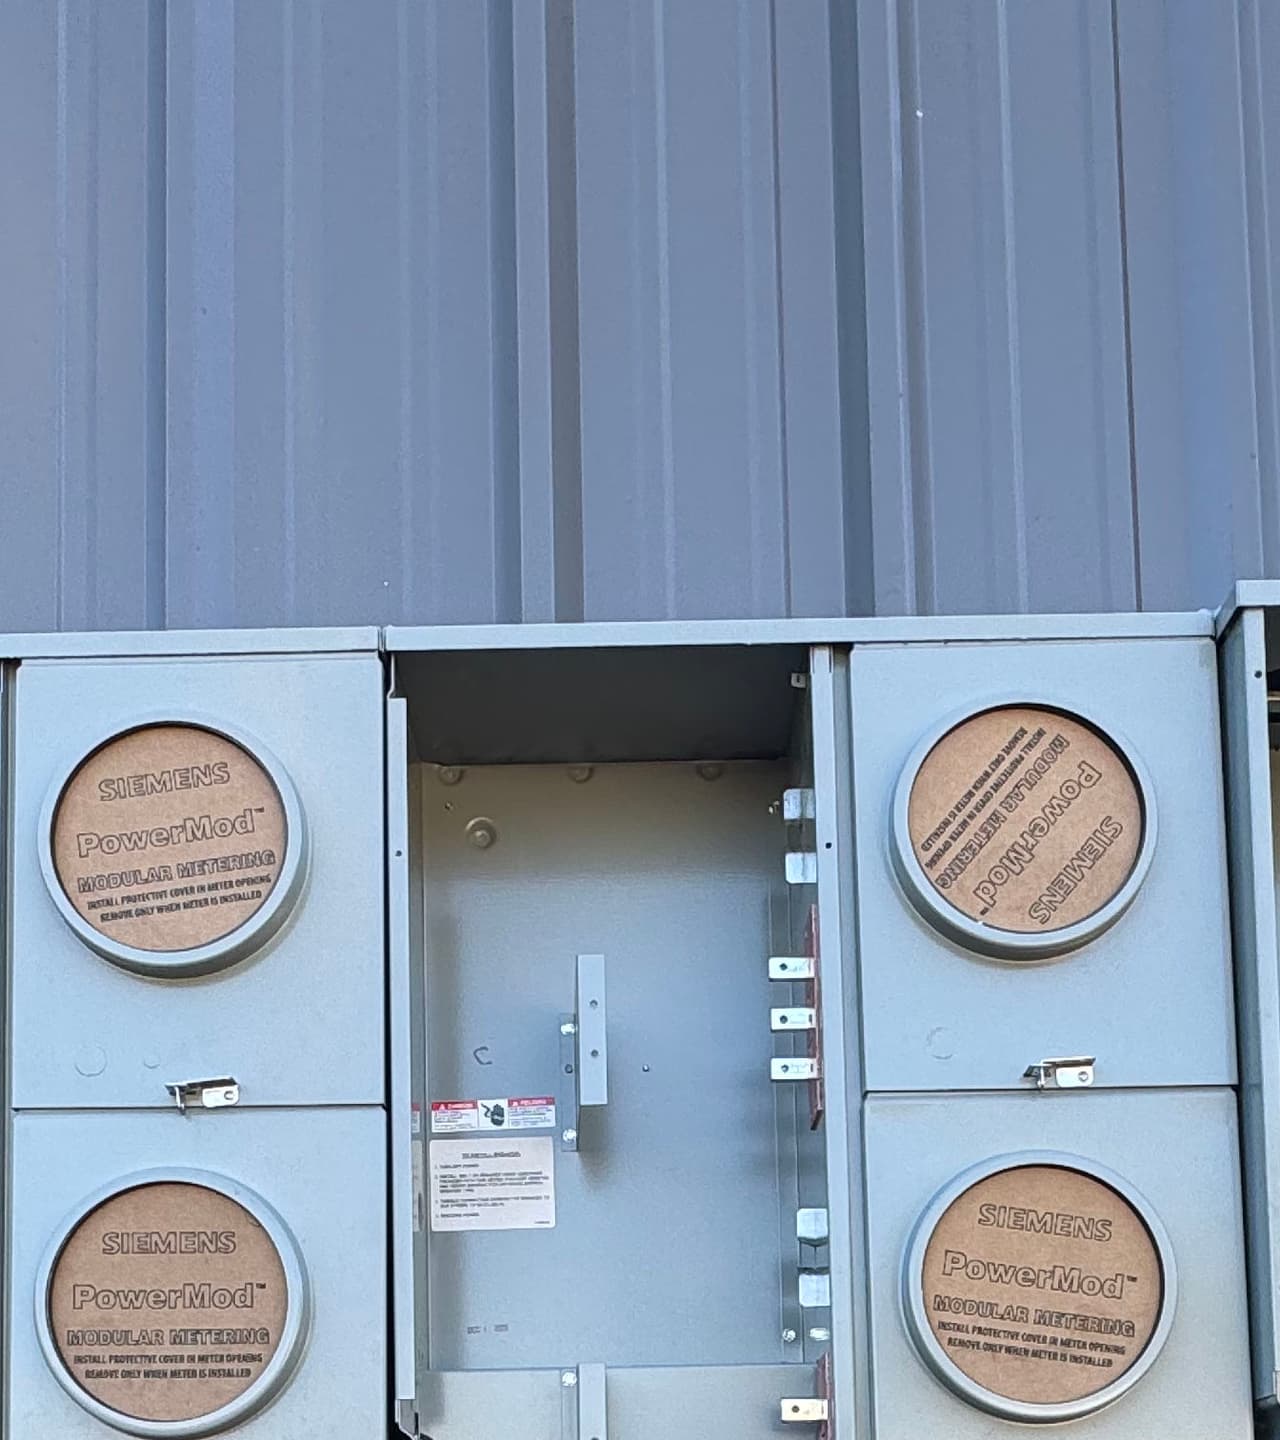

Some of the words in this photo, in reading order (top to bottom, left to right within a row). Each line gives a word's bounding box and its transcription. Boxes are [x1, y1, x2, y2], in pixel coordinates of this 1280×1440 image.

[98, 762, 230, 801] SIEMENS
[1004, 733, 1070, 813] MODULAR
[936, 809, 1008, 889] METERING
[78, 866, 173, 893] MODULAR
[177, 850, 275, 878] METERING
[1029, 816, 1123, 924] SIEMENS
[170, 887, 195, 898] COVER
[473, 1046, 493, 1065] C
[978, 1203, 1112, 1241] SIEMENS
[102, 1231, 236, 1254] SIEMENS
[933, 1295, 1029, 1323] MODULAR
[1033, 1308, 1135, 1337] METERING
[67, 1329, 164, 1346] MODULAR
[169, 1328, 270, 1345] METERING
[1022, 1333, 1047, 1344] COVER
[159, 1354, 185, 1363] COVER
